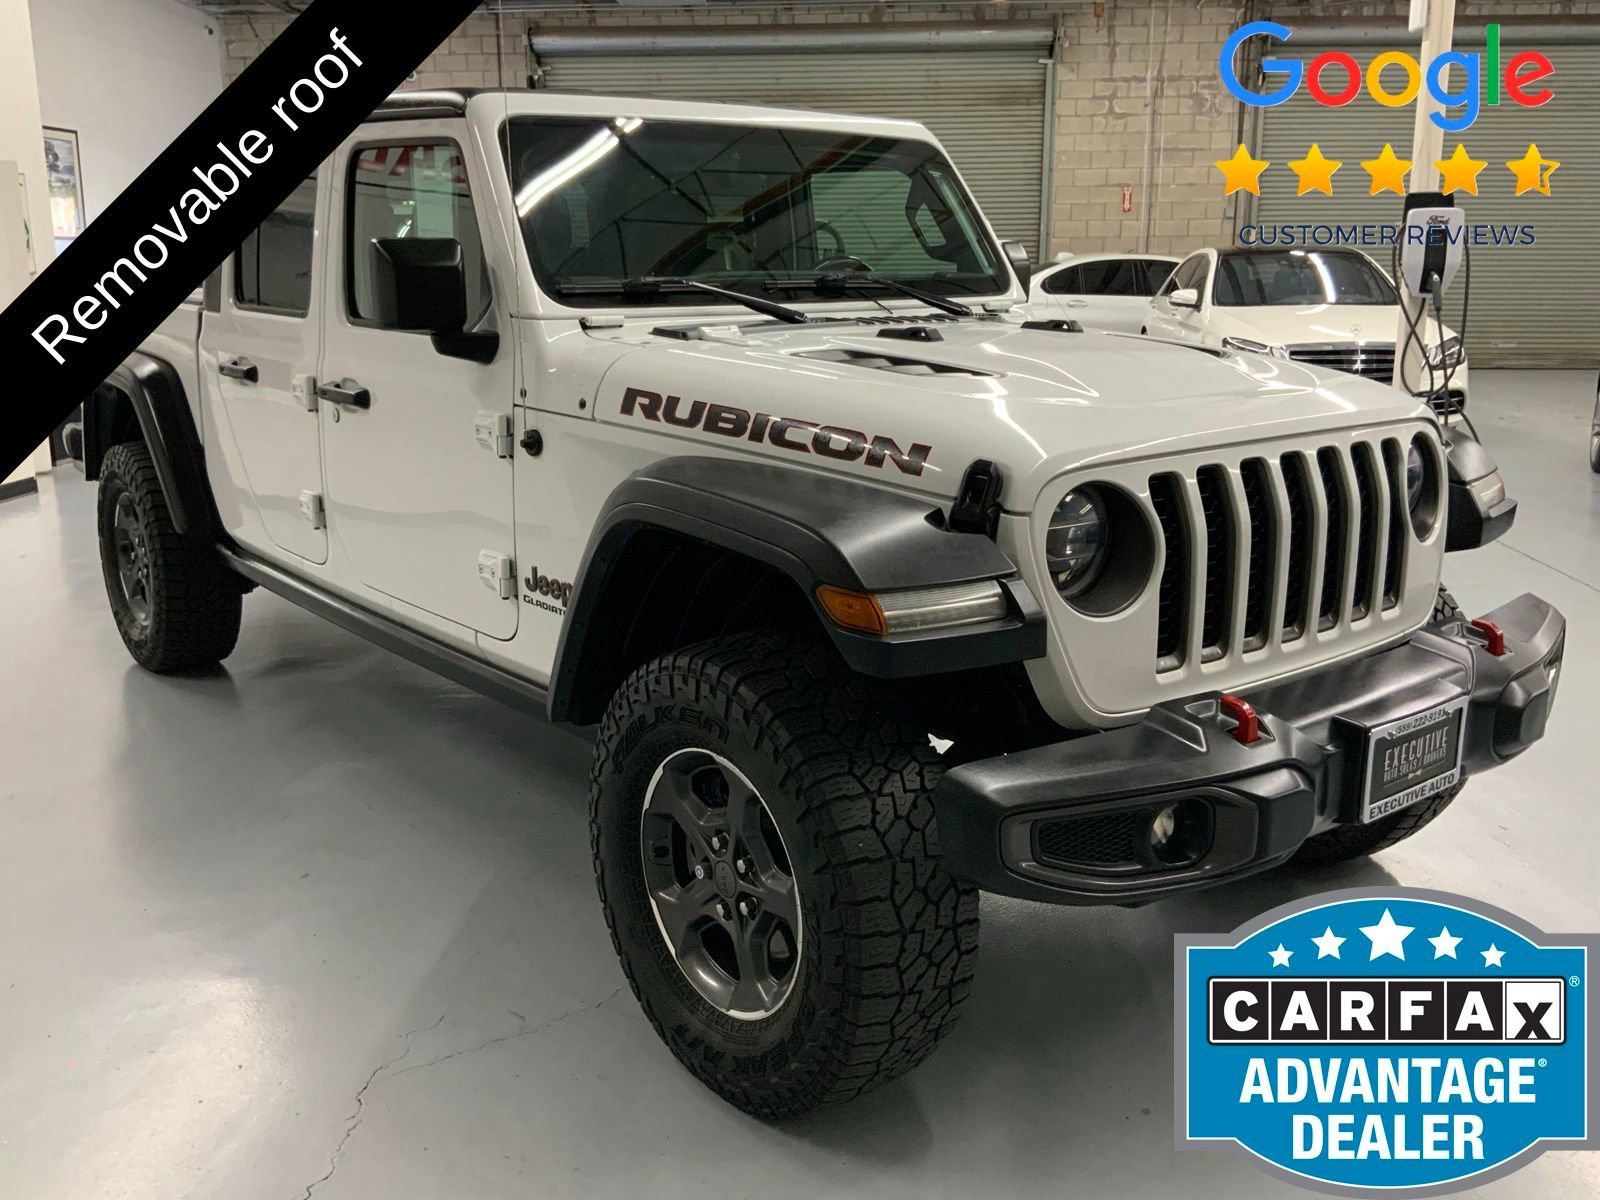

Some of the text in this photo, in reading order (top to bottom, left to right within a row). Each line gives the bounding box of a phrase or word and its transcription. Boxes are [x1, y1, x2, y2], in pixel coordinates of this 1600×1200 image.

[1427, 215, 1451, 225] Ford
[620, 387, 933, 476] RUBICON
[523, 594, 567, 616] GLADIAT
[524, 565, 573, 608] Jeep
[1384, 726, 1449, 771] EXECUTIVE
[1369, 773, 1455, 820] EXECUTIVE AUTO
